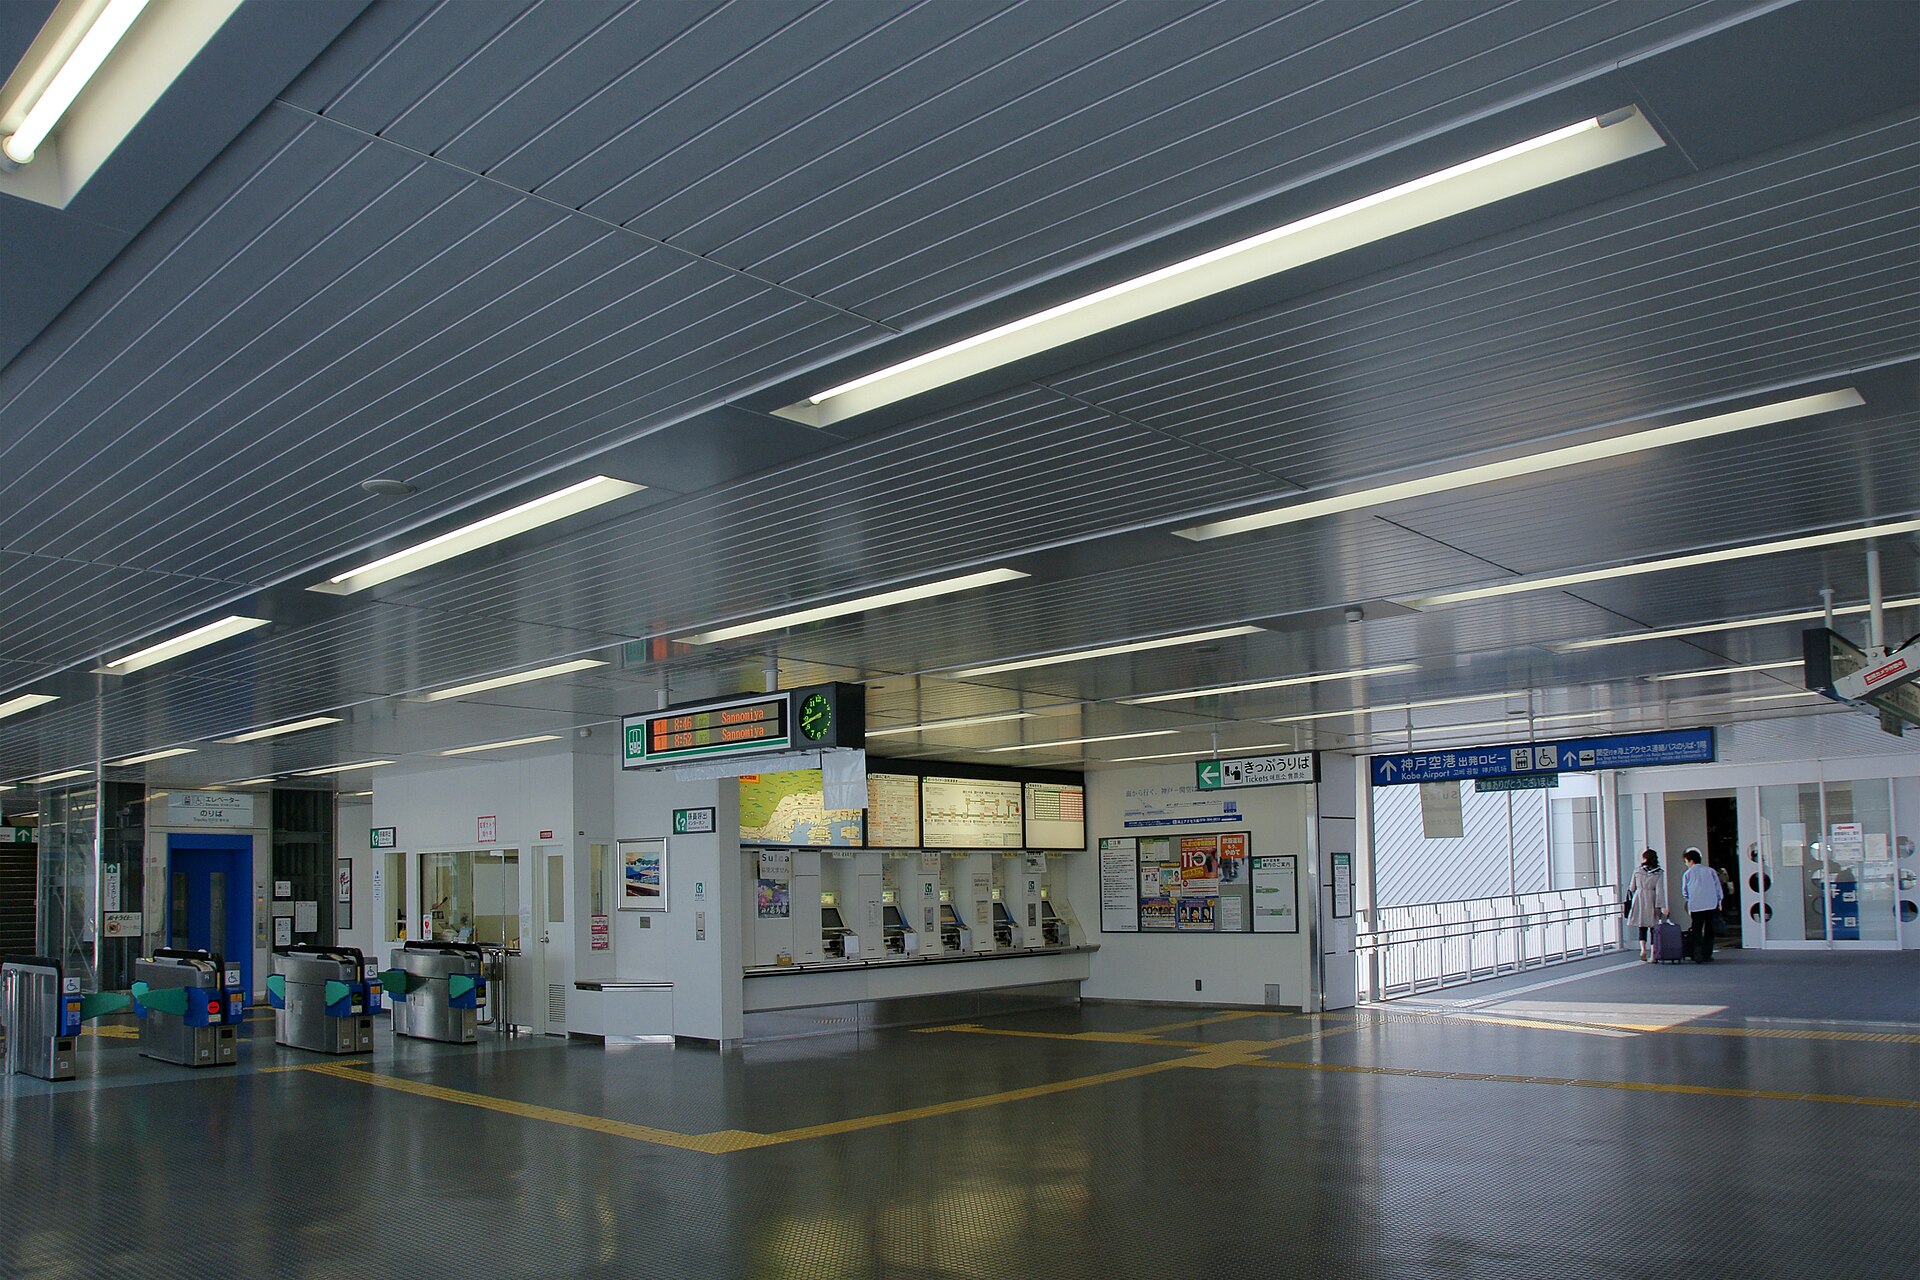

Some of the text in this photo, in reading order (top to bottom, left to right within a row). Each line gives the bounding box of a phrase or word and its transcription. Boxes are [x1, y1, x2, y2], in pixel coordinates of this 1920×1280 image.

[674, 716, 692, 730] 8:46
[721, 708, 764, 725] Sannomiya
[674, 732, 693, 747] 8:52
[721, 726, 764, 742] Sannomiya
[1244, 755, 1310, 774] きっぷうりば
[1401, 754, 1507, 772] 神戸空港 出発ロビー
[1244, 774, 1268, 783] Tickets
[1401, 772, 1421, 780] Kobe
[1422, 769, 1450, 780] Airport
[200, 809, 223, 818] のりば
[761, 853, 790, 862] Suica
[1182, 851, 1207, 868] 110
